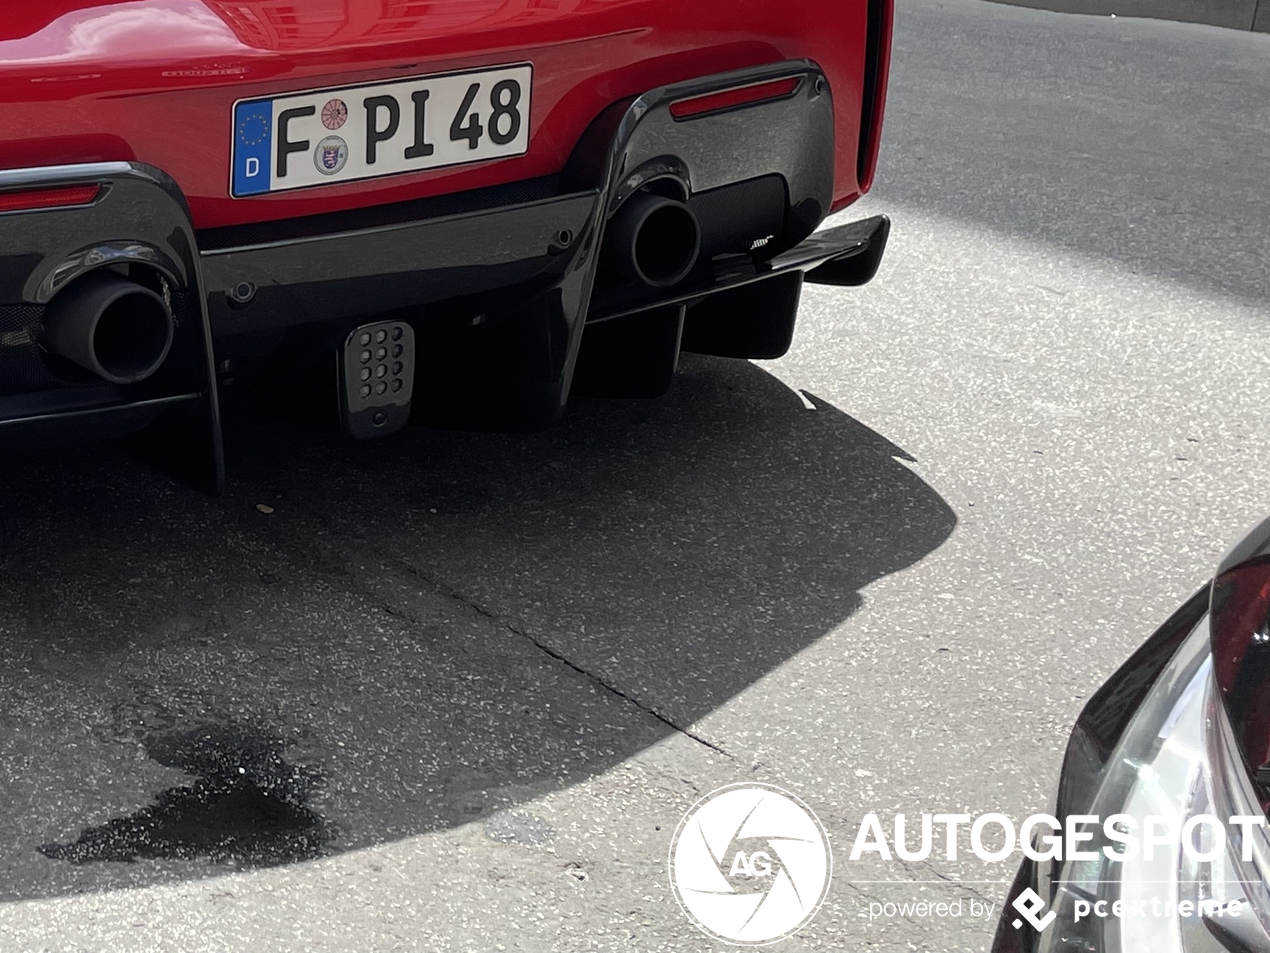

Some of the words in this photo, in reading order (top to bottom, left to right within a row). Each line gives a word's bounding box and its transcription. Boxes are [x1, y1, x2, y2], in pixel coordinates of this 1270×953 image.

[363, 89, 434, 165] PI
[449, 79, 521, 150] 48
[245, 157, 261, 178] D
